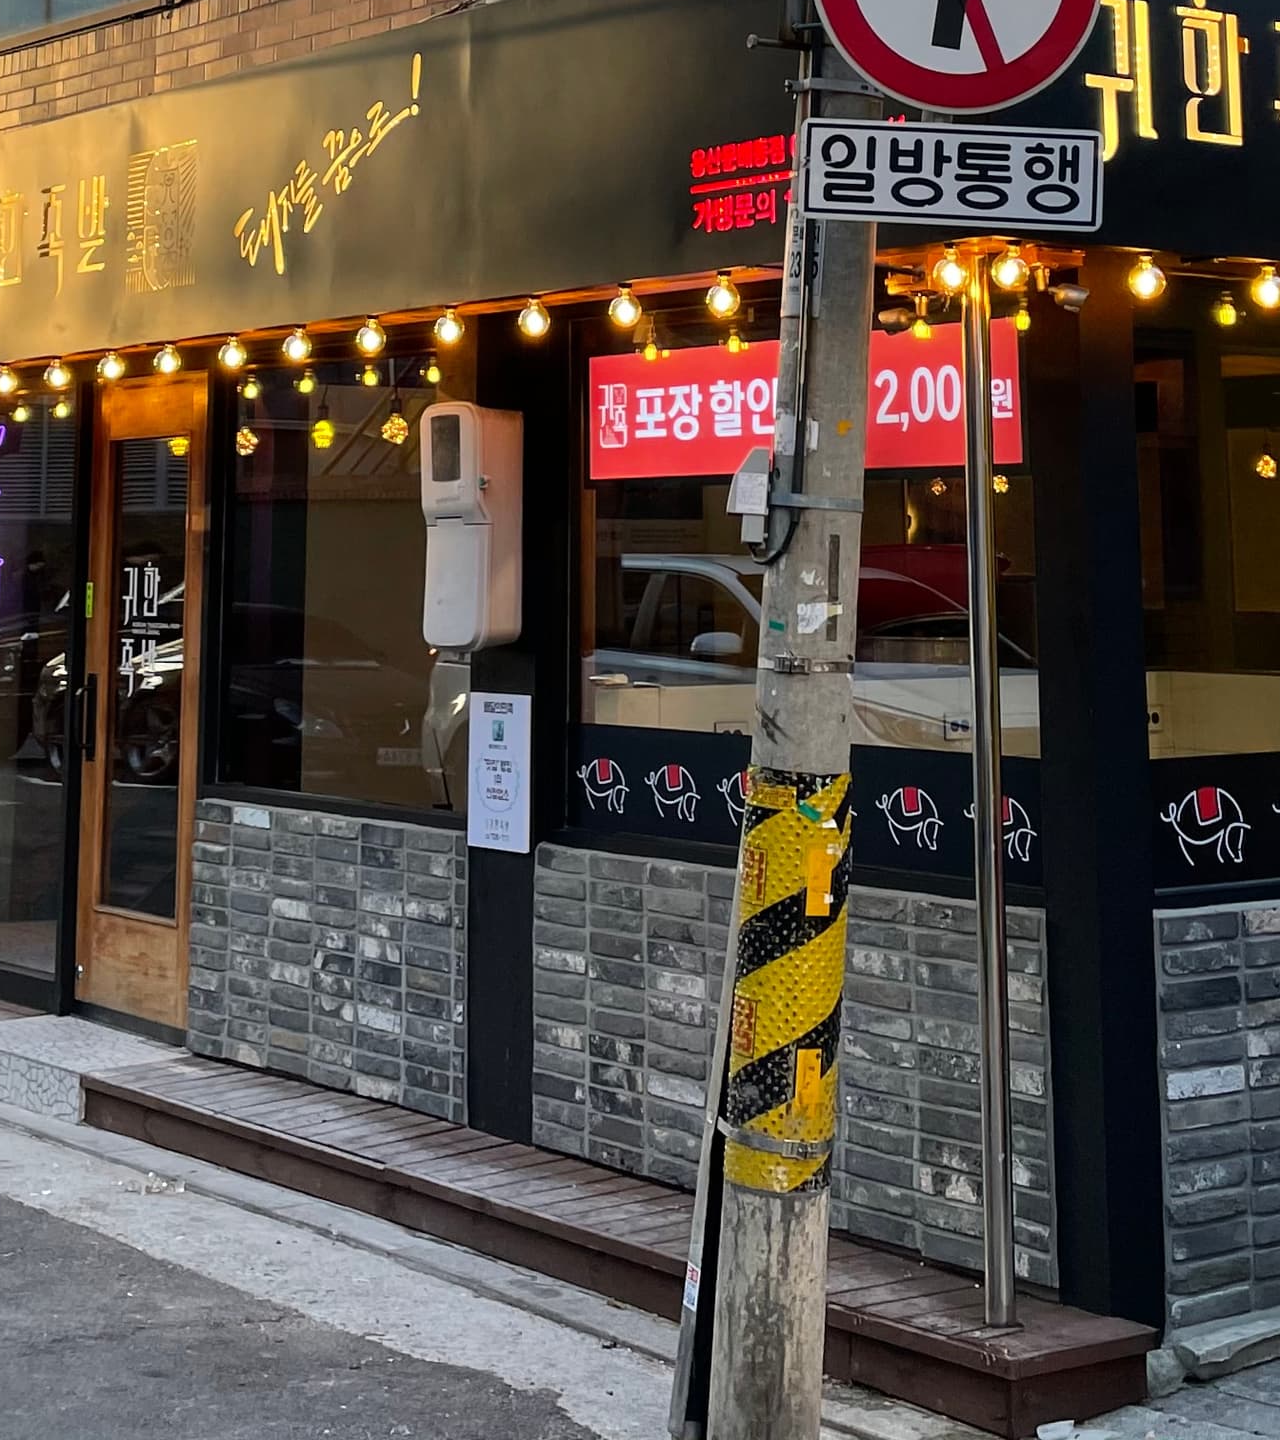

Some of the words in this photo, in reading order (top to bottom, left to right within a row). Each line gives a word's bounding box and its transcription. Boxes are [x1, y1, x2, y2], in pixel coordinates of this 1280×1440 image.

[692, 188, 777, 233] 가맹문의
[821, 133, 1082, 216] 일방통행
[634, 384, 704, 441] 포장
[708, 375, 778, 440] 할인
[873, 364, 1015, 433] 2,00원
